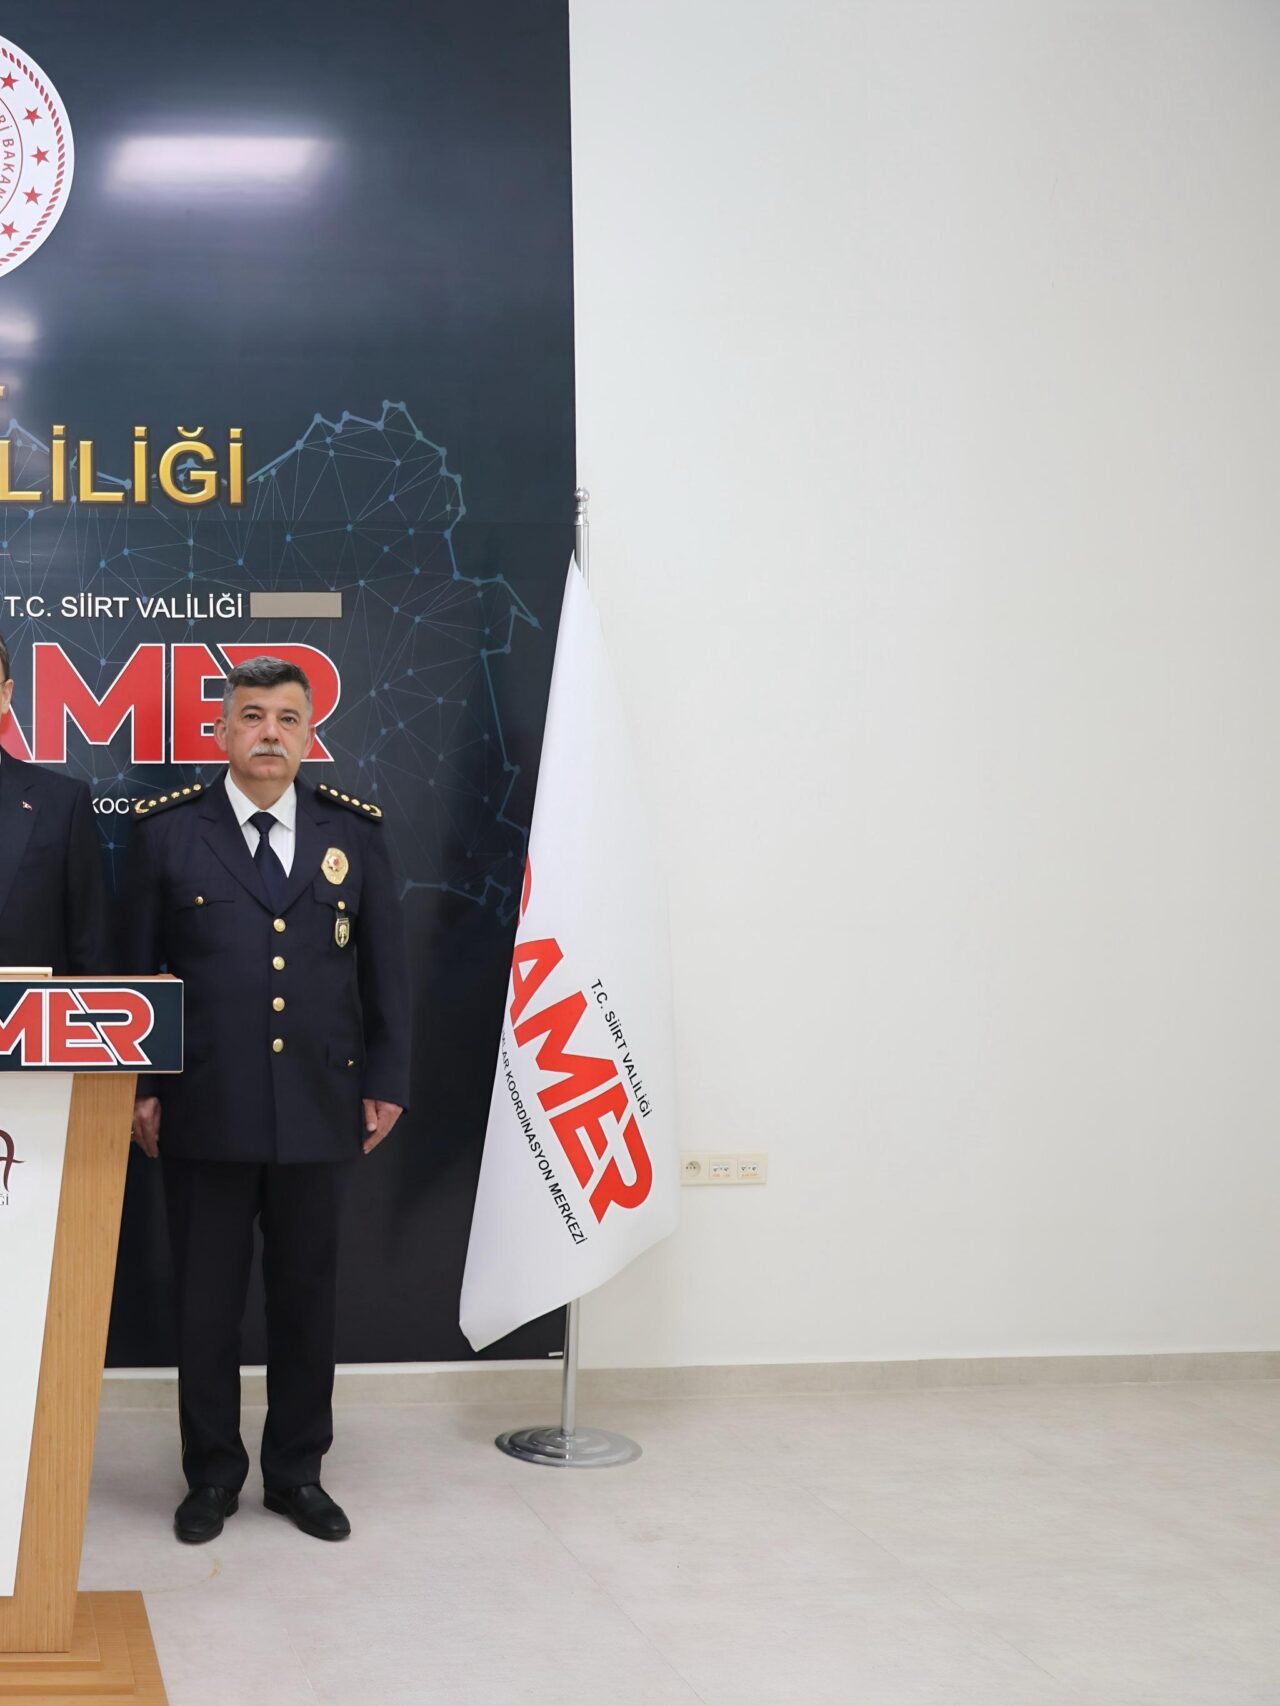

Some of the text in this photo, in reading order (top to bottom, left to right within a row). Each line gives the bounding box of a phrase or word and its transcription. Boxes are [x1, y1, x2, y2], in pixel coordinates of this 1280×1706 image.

[4, 592, 243, 618] T.C. SİİRT VALİLİĞİ
[591, 978, 653, 1119] T.C. SİİRT VALİLİĞİ
[505, 1070, 555, 1182] KOORDİNASYON
[548, 1182, 588, 1246] MERKEZİ
